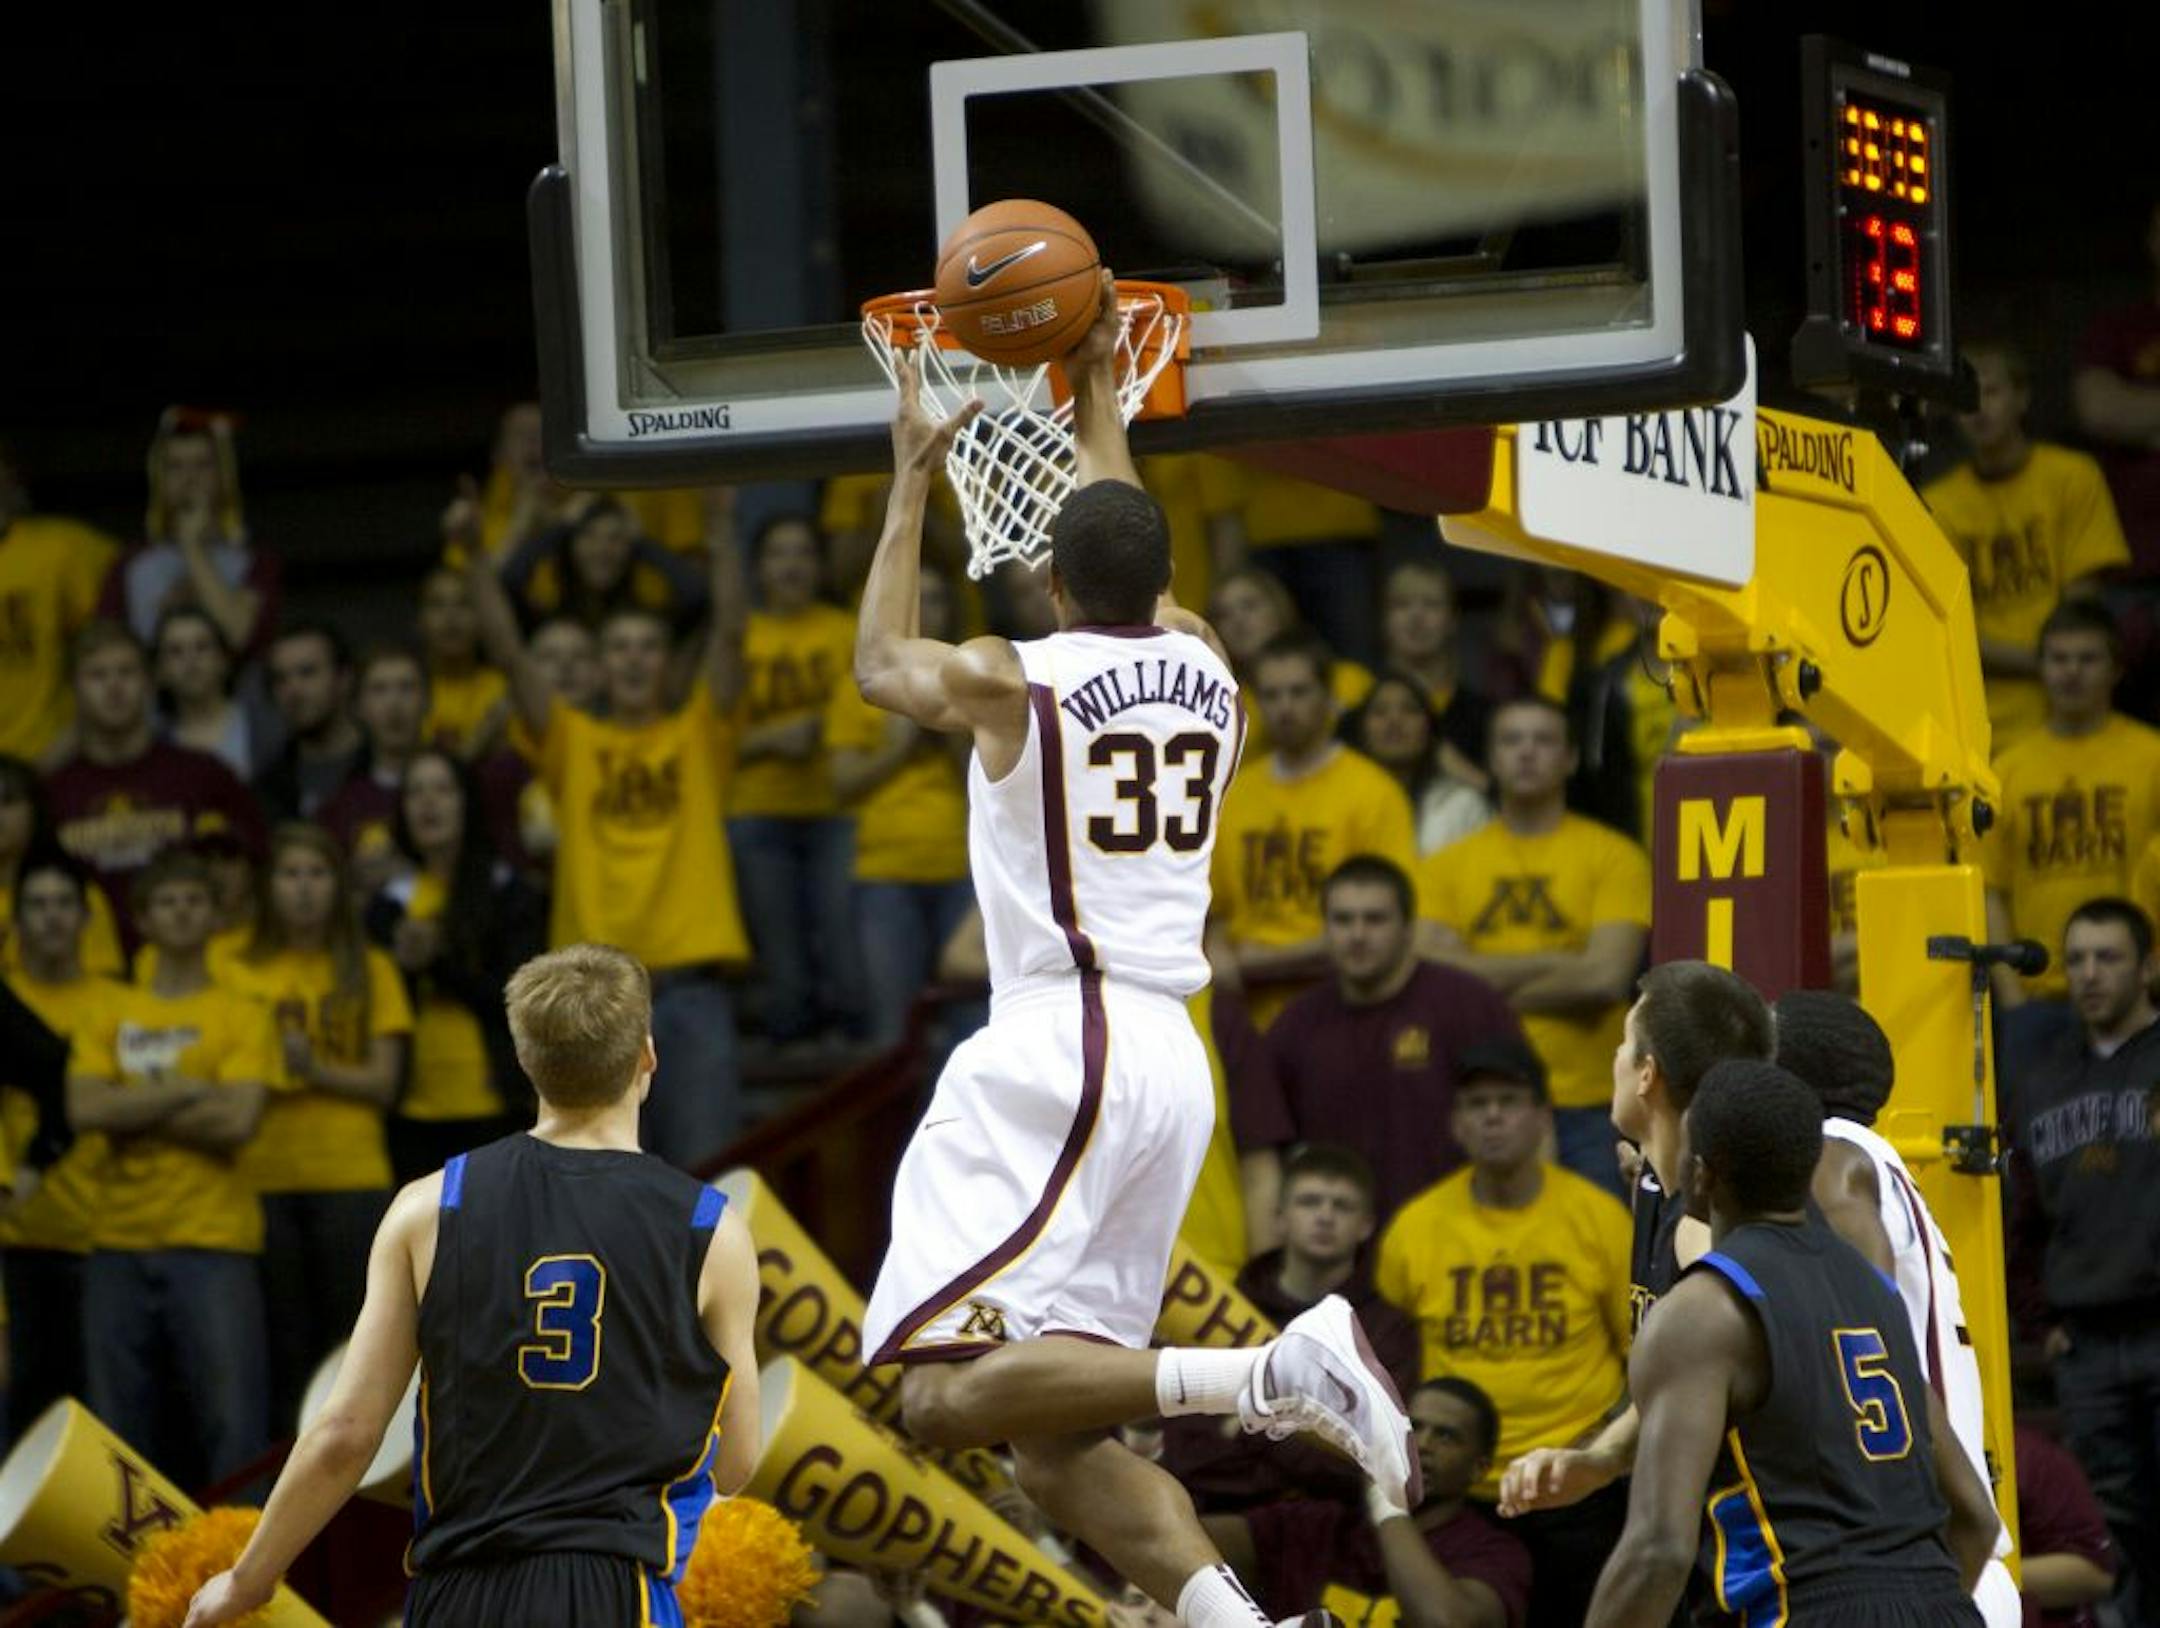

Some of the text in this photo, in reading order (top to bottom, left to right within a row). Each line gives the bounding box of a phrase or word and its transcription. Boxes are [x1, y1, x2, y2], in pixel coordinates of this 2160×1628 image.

[627, 404, 731, 437] SPALDING
[1622, 406, 1743, 500] BANK
[1060, 659, 1231, 733] WILLIAMS
[1086, 731, 1220, 853] 33
[517, 1253, 608, 1391] 3
[1831, 1327, 1914, 1461] 5
[774, 1443, 1098, 1628] GOPHERS
